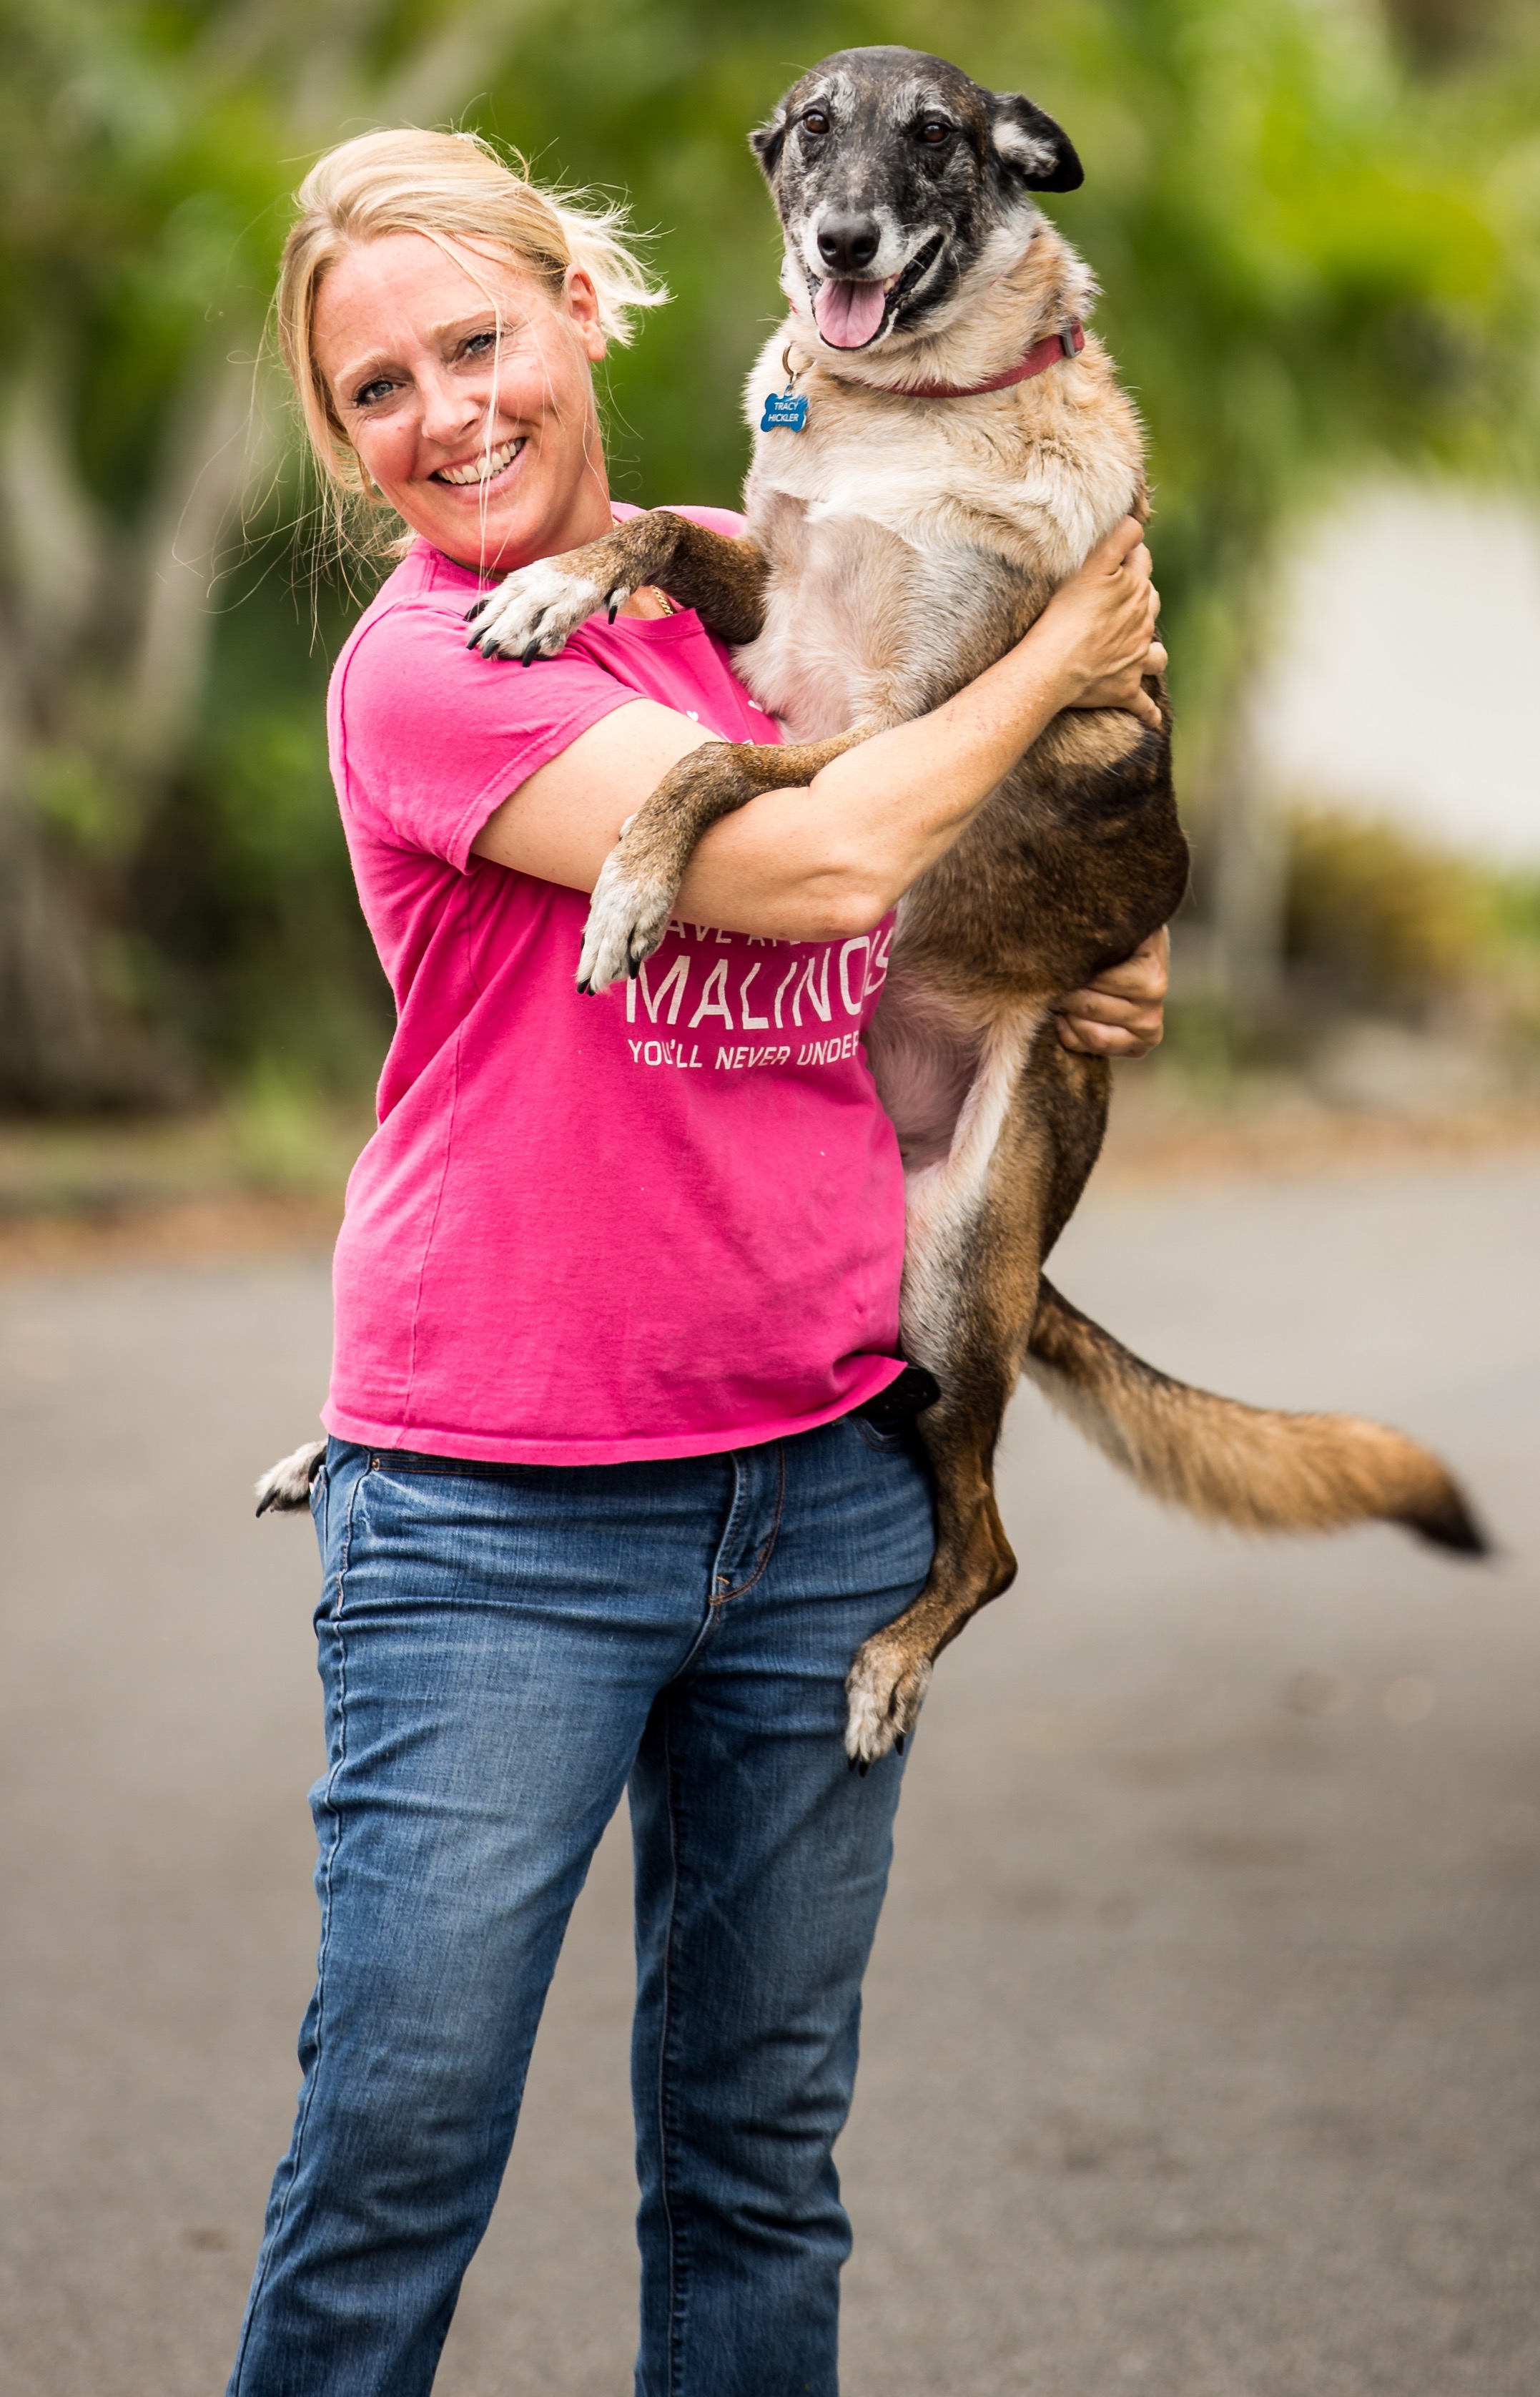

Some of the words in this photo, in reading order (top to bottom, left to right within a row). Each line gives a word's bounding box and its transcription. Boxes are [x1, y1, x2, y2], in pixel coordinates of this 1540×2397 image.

[774, 402, 799, 410] TRACY
[768, 413, 799, 422] HICKLER
[627, 1038, 704, 1068] YOU'LL
[714, 1045, 791, 1070] NEVER
